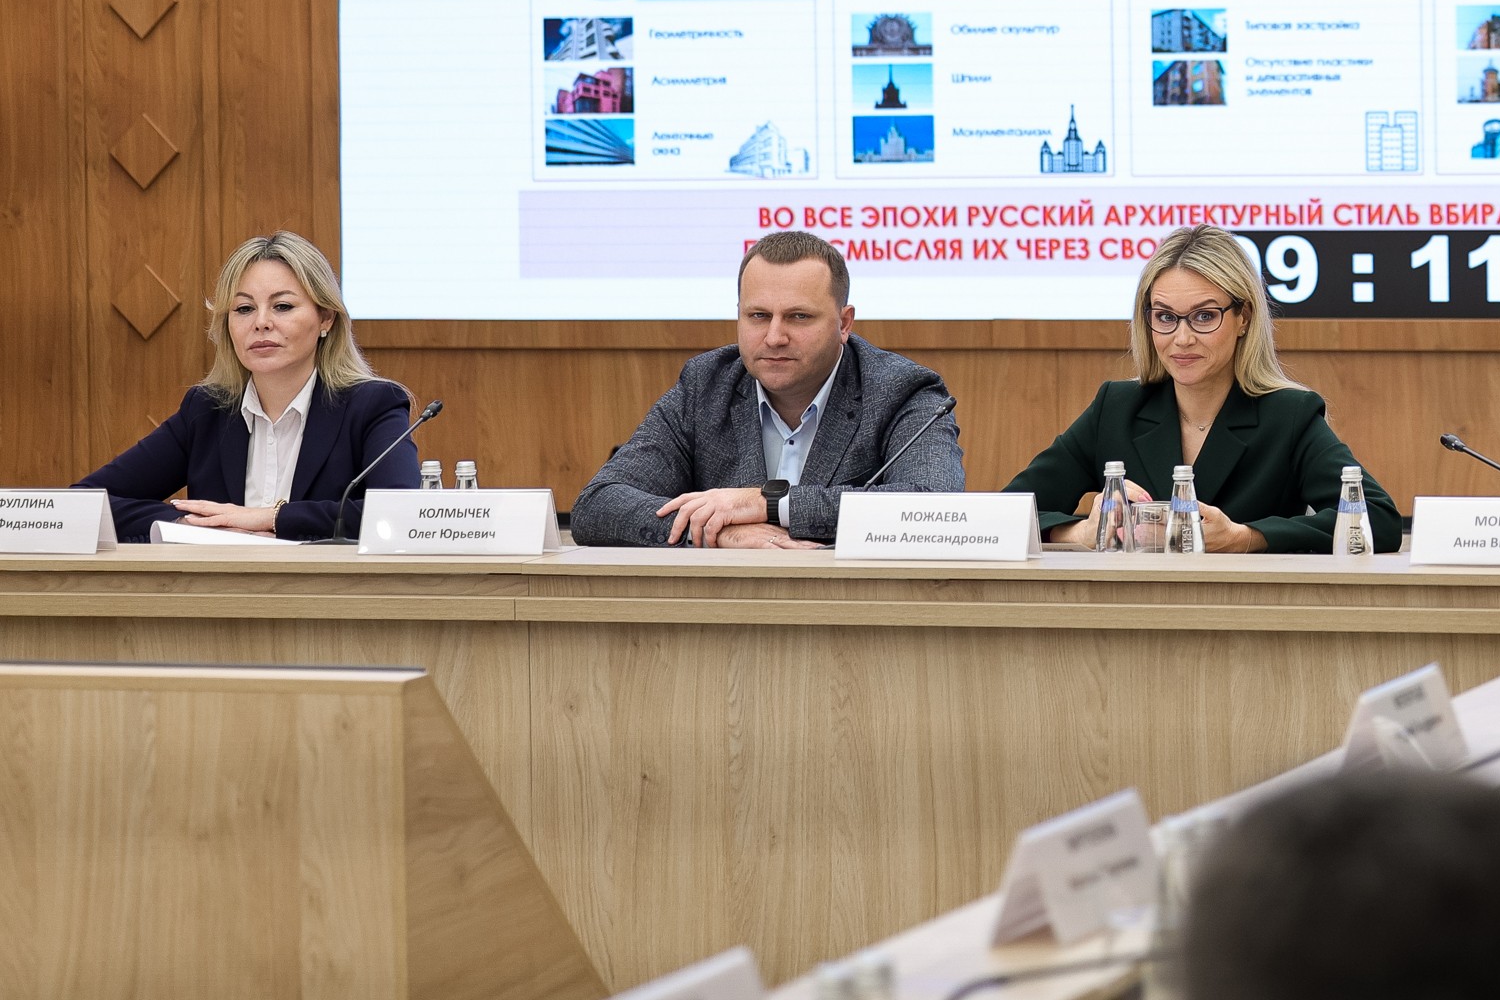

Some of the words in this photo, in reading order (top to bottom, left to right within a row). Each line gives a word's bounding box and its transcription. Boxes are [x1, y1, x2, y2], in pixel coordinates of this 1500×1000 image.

[759, 206, 794, 228] ВО
[803, 206, 853, 228] ВСЕ
[861, 206, 957, 228] ЭПОХИ
[968, 199, 1094, 228] РУССКИЙ
[1104, 198, 1323, 228] АРХИТЕКТУРНЫЙ
[1333, 203, 1420, 226] СТИЛЬ
[973, 239, 1008, 260] ИХ
[1016, 238, 1090, 260] ЧЕРЕЗ
[1099, 237, 1163, 261] СВО
[418, 507, 491, 519] КОЛМЫЧЕК
[900, 511, 968, 523] МОЖАЕВА
[408, 528, 438, 540] Олег
[439, 528, 496, 542] Юрьевич
[864, 531, 897, 543] Анна
[899, 532, 999, 547] Александровна
[1453, 536, 1487, 549] Анна
